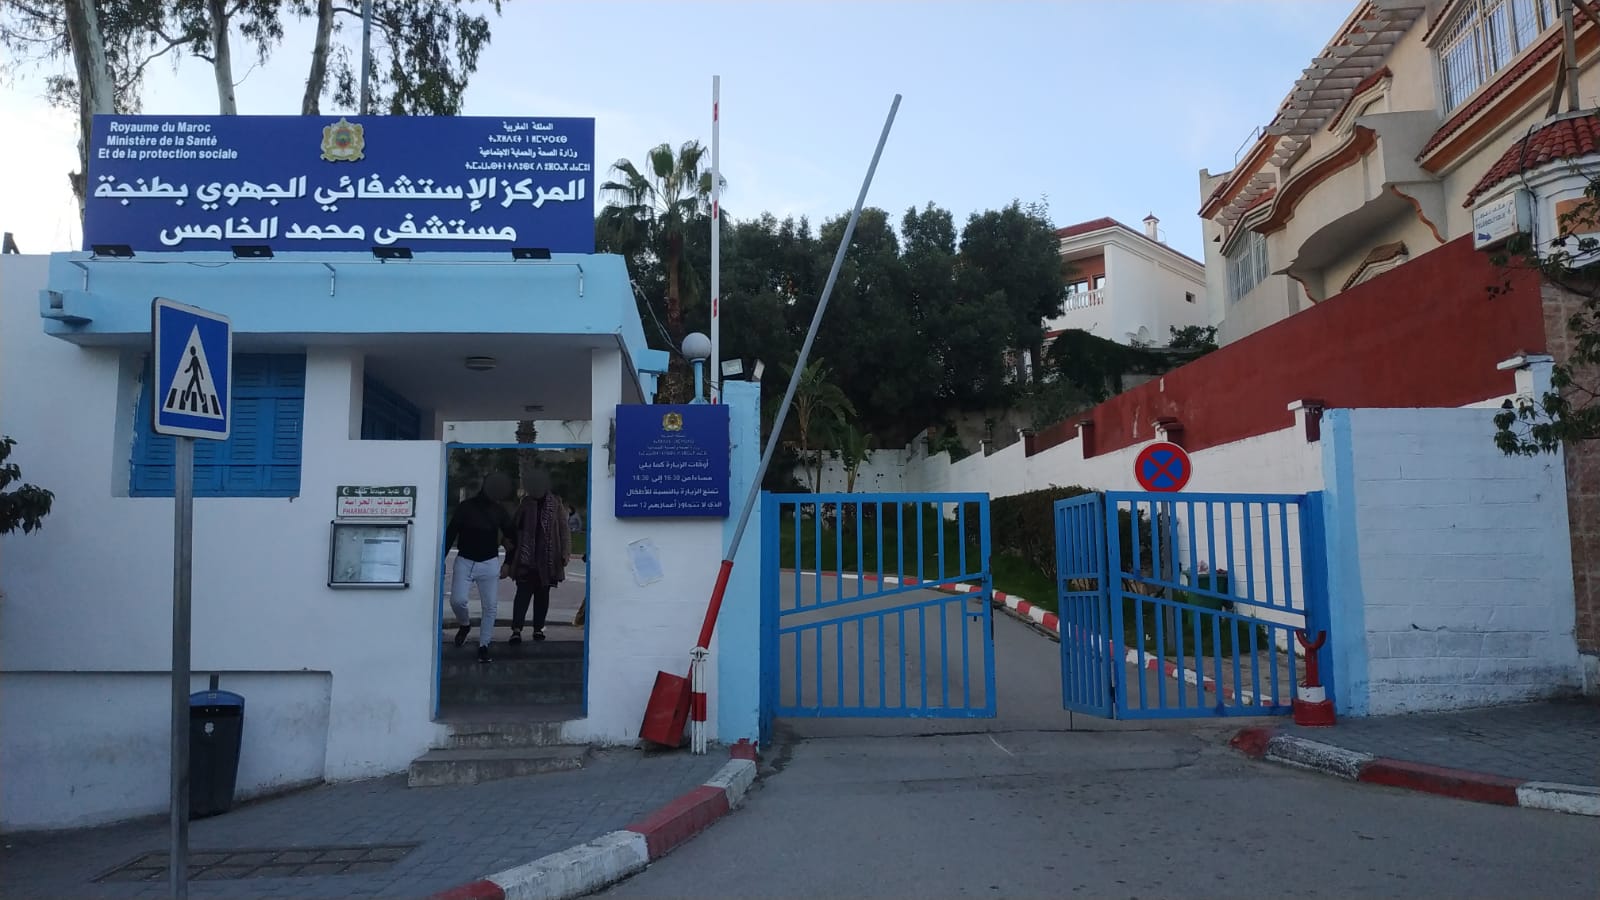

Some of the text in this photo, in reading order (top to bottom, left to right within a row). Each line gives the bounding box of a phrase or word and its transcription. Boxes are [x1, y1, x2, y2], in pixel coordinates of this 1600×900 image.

[110, 122, 211, 135] Royaume du Maroc
[503, 121, 553, 132] المملكة المغربية
[107, 135, 217, 146] Ministère de la Santé
[98, 148, 238, 161] Et de la protection sociale
[511, 147, 536, 158] والحماية
[538, 147, 557, 156] الصحة
[559, 148, 578, 158] وزارة
[94, 172, 586, 213] المركز الإستشفائي الجهوي بطنجة
[159, 213, 517, 246] مستشفى محمد الخامس
[666, 461, 687, 469] الزيارة
[343, 507, 410, 515] PHARMACIES DE GARDE
